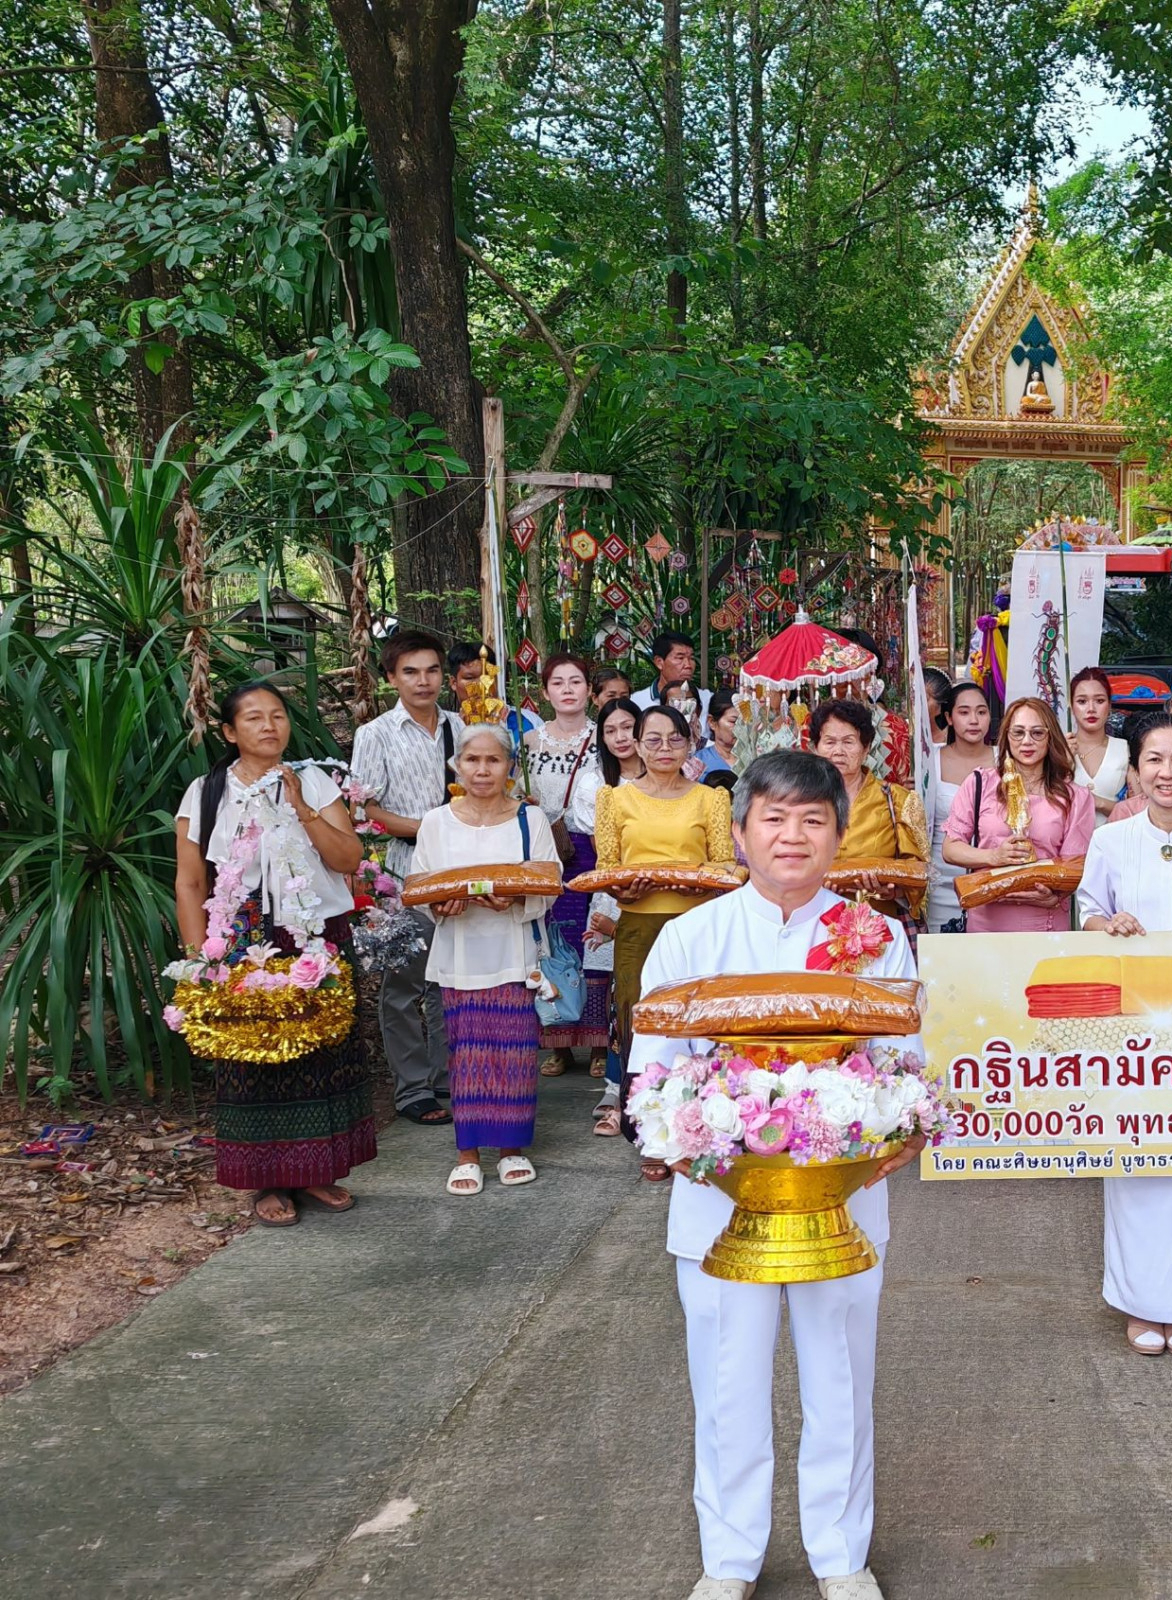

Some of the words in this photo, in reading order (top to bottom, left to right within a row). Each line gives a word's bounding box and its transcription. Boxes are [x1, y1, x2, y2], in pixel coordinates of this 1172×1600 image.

[952, 1103, 1104, 1142] 30,000วัด
[932, 1152, 965, 1171] โดย
[972, 1149, 1114, 1174] คณะศิษยานุศิษย์
